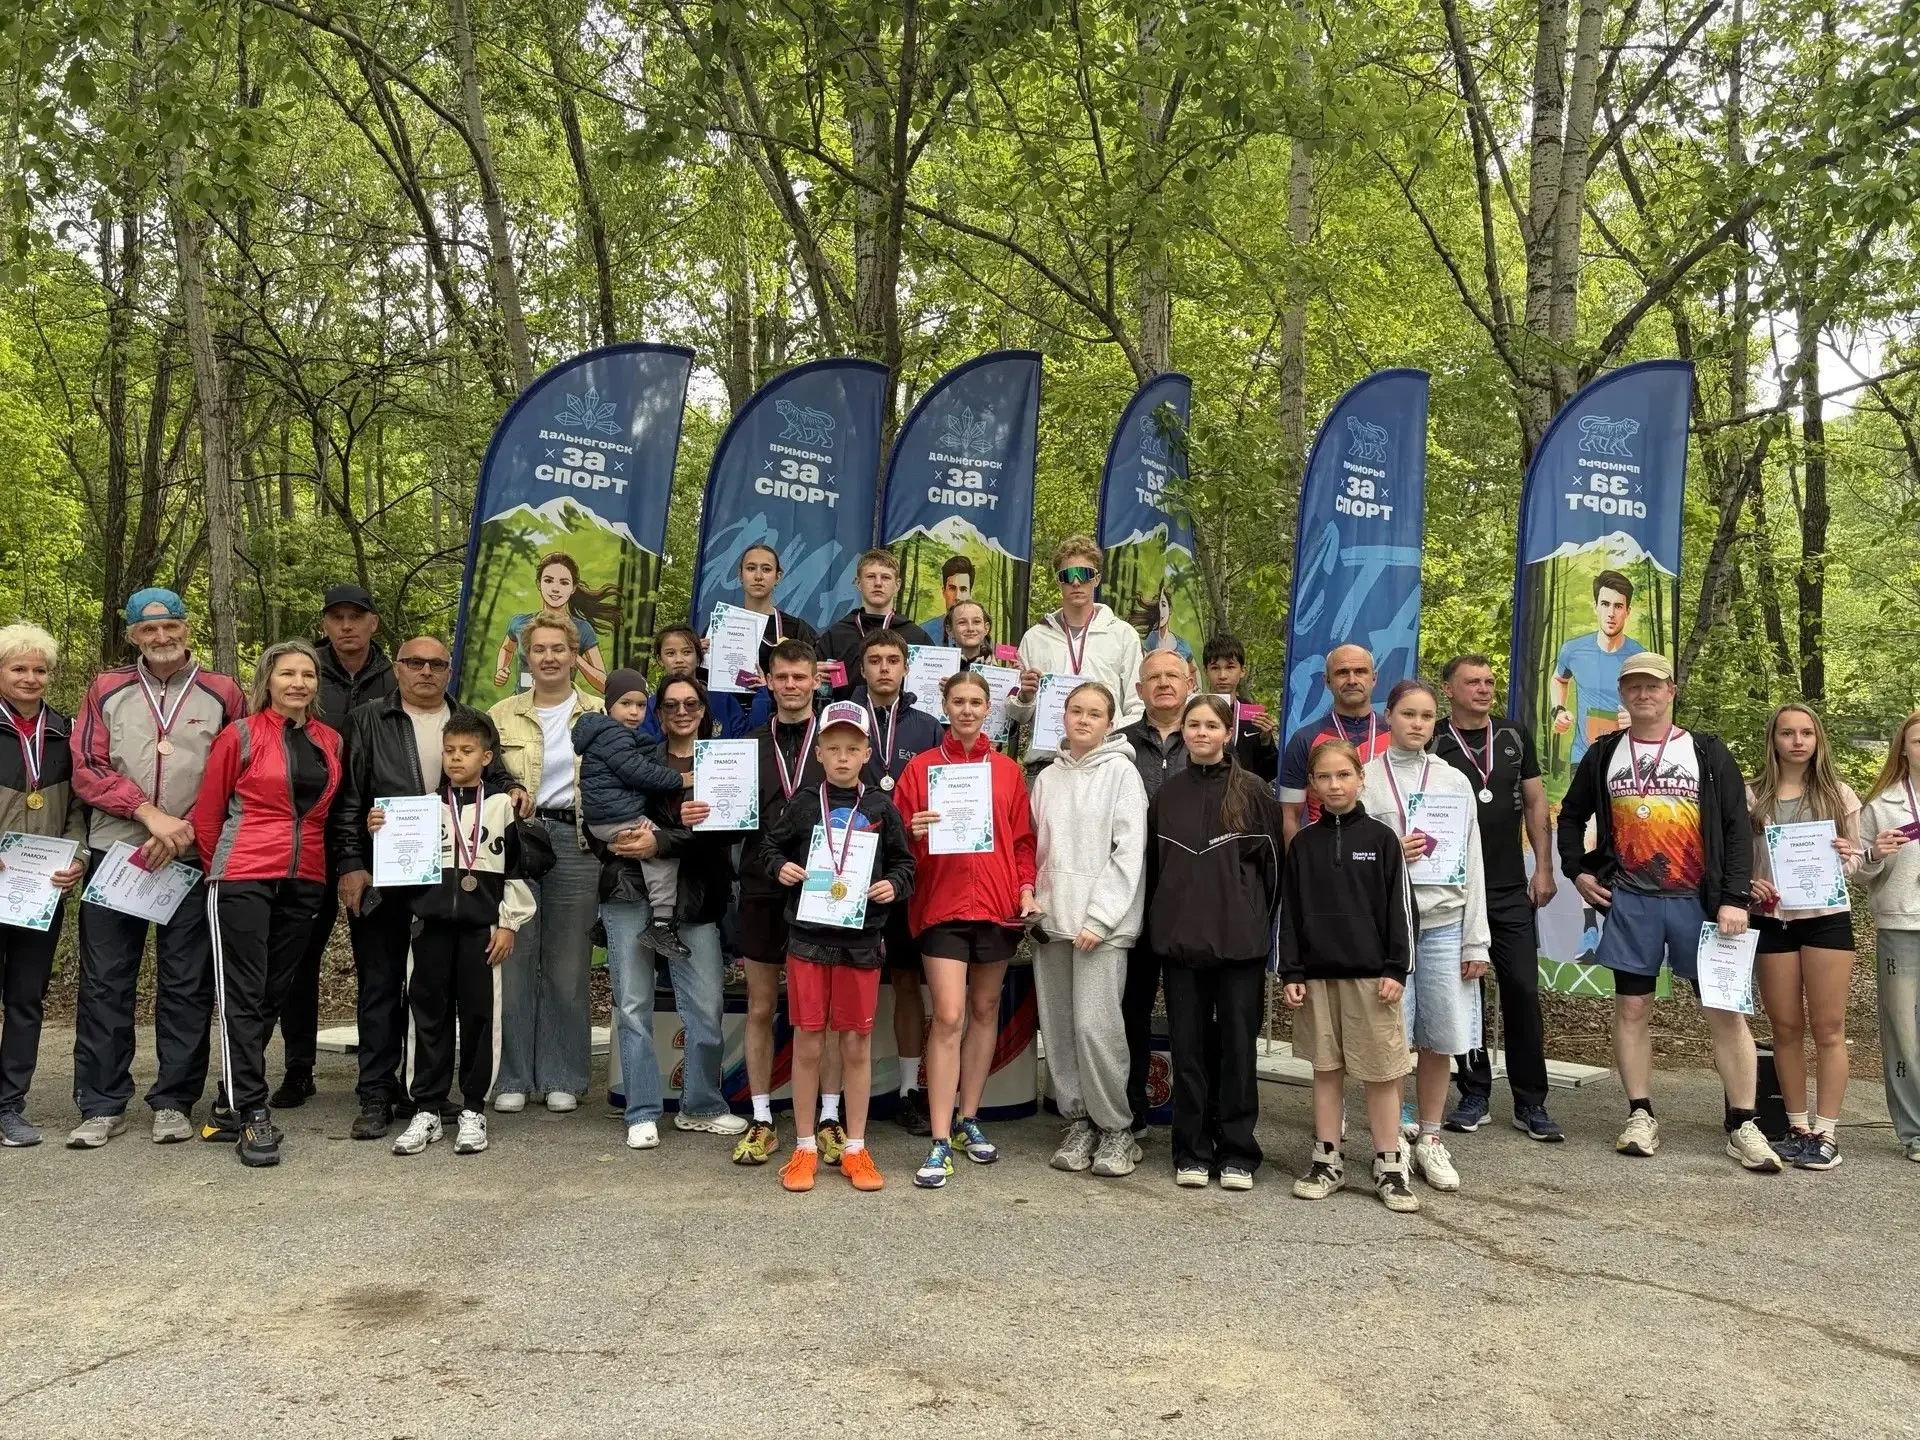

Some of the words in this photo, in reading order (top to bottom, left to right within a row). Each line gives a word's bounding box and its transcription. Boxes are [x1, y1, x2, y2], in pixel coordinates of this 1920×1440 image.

[535, 464, 628, 494] СПОРТ
[755, 477, 840, 508] СПОРТ
[928, 486, 999, 510] СПОРТ
[1336, 494, 1393, 521] СПОРТ
[20, 852, 47, 861] ГРАМОТА
[1716, 943, 1738, 951] ГРАМОТА
